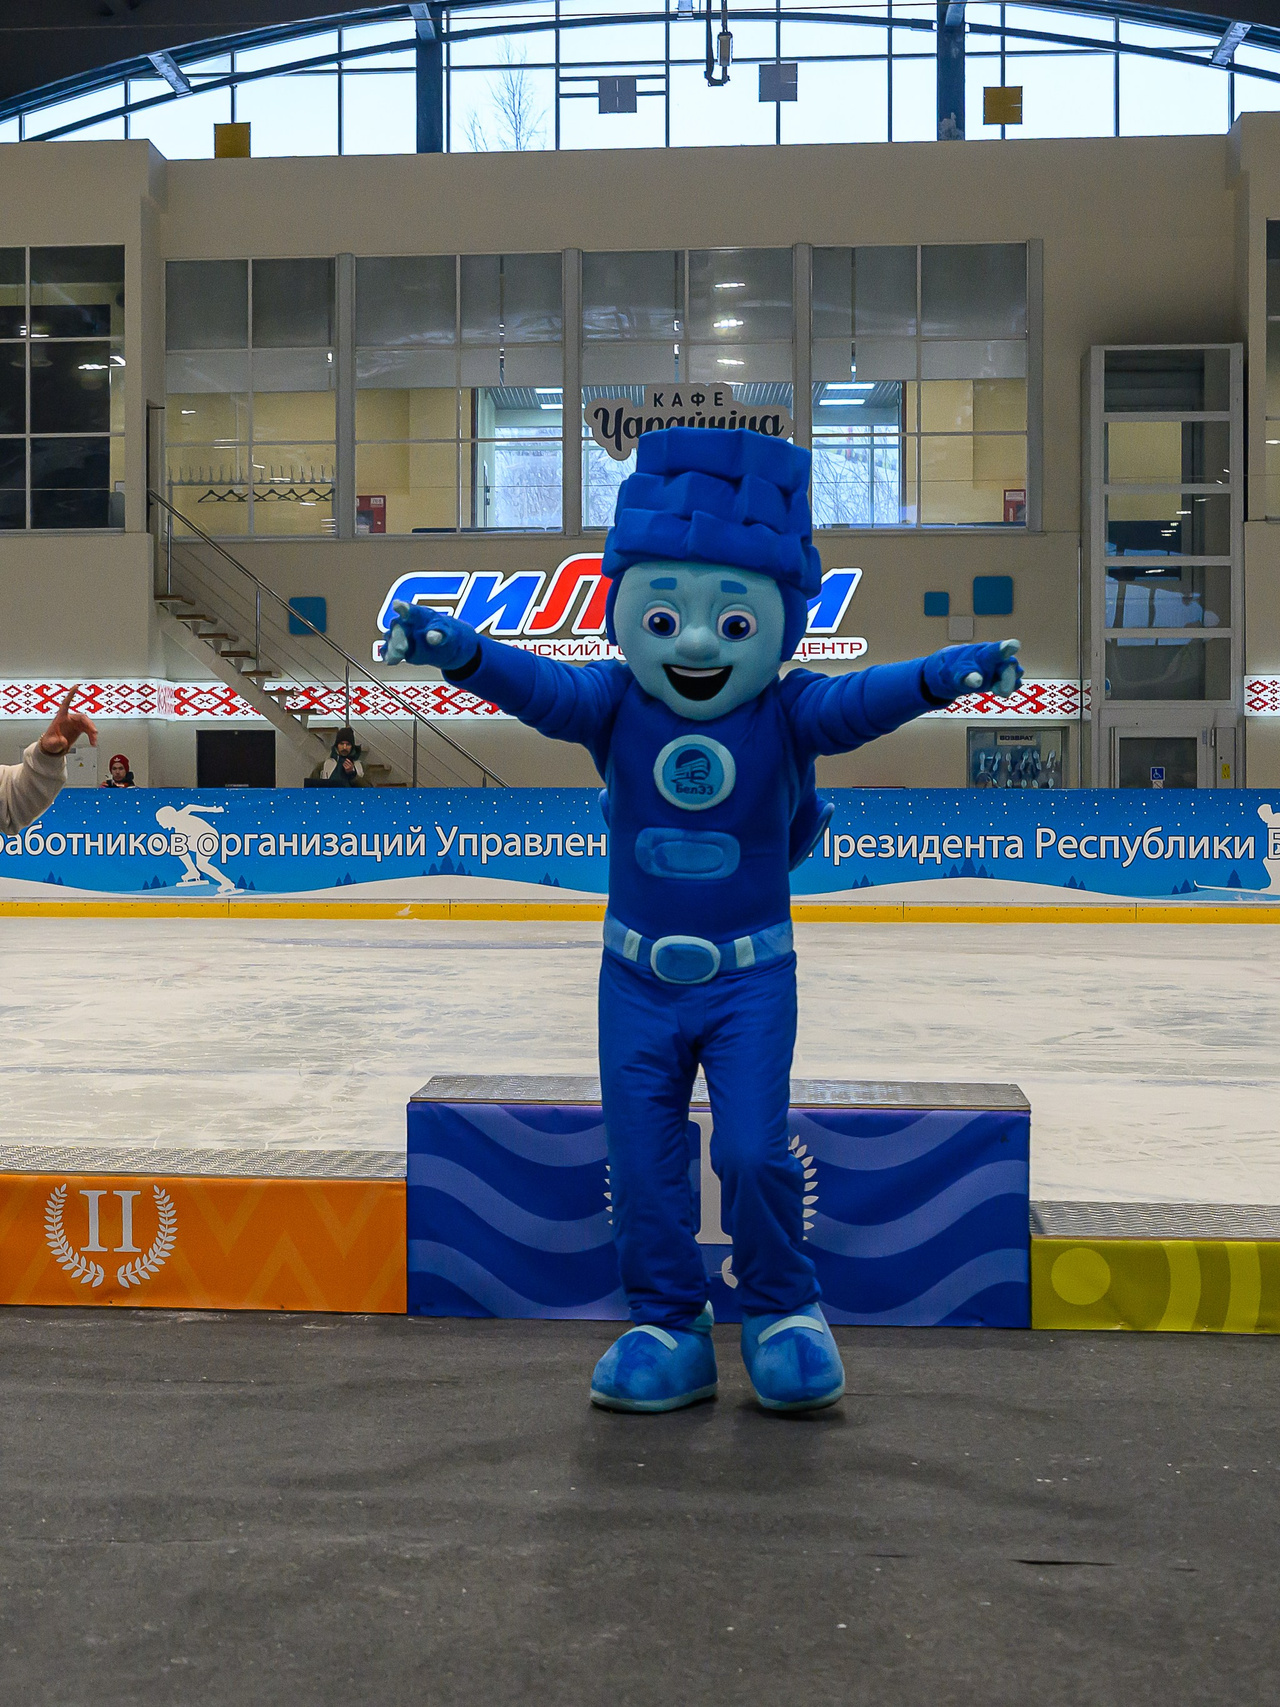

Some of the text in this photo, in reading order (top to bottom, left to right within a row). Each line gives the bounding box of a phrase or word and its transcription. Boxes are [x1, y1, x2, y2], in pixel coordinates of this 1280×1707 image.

[653, 392, 724, 407] КАФЕ
[378, 554, 860, 635] СИЛИ
[196, 825, 426, 864] организаций
[435, 825, 607, 864] Управлен
[1035, 826, 1256, 868] Республики
[79, 1190, 141, 1252] II
